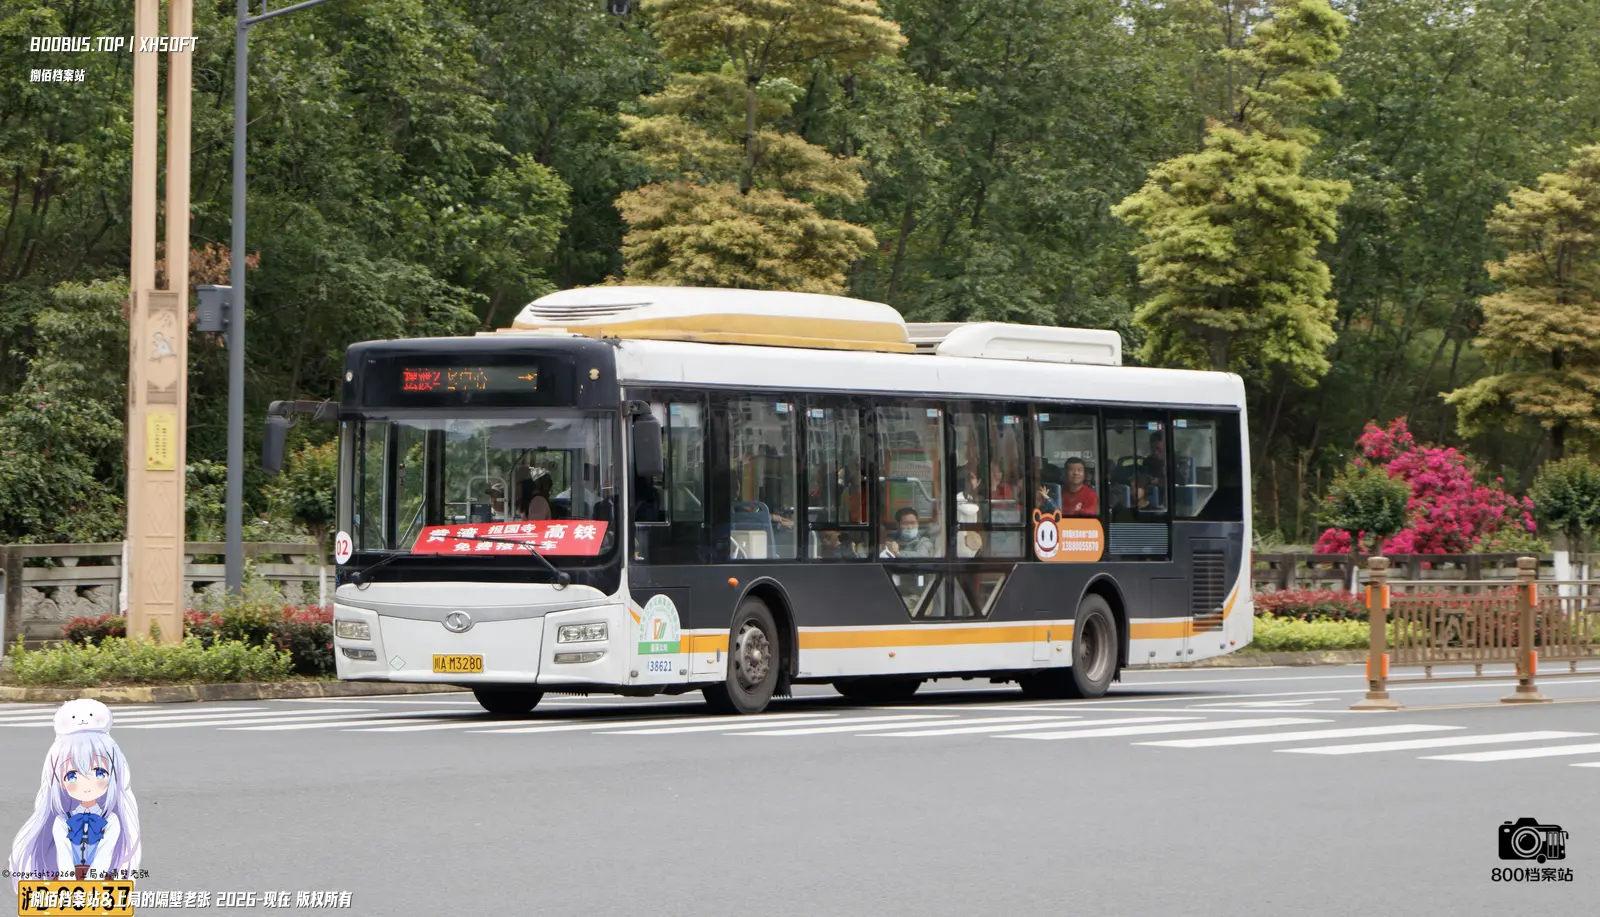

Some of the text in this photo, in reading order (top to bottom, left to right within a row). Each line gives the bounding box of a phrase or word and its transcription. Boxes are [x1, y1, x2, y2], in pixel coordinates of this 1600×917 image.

[487, 523, 537, 535] 报国寺
[544, 523, 597, 541] 高铁
[336, 539, 349, 556] 02
